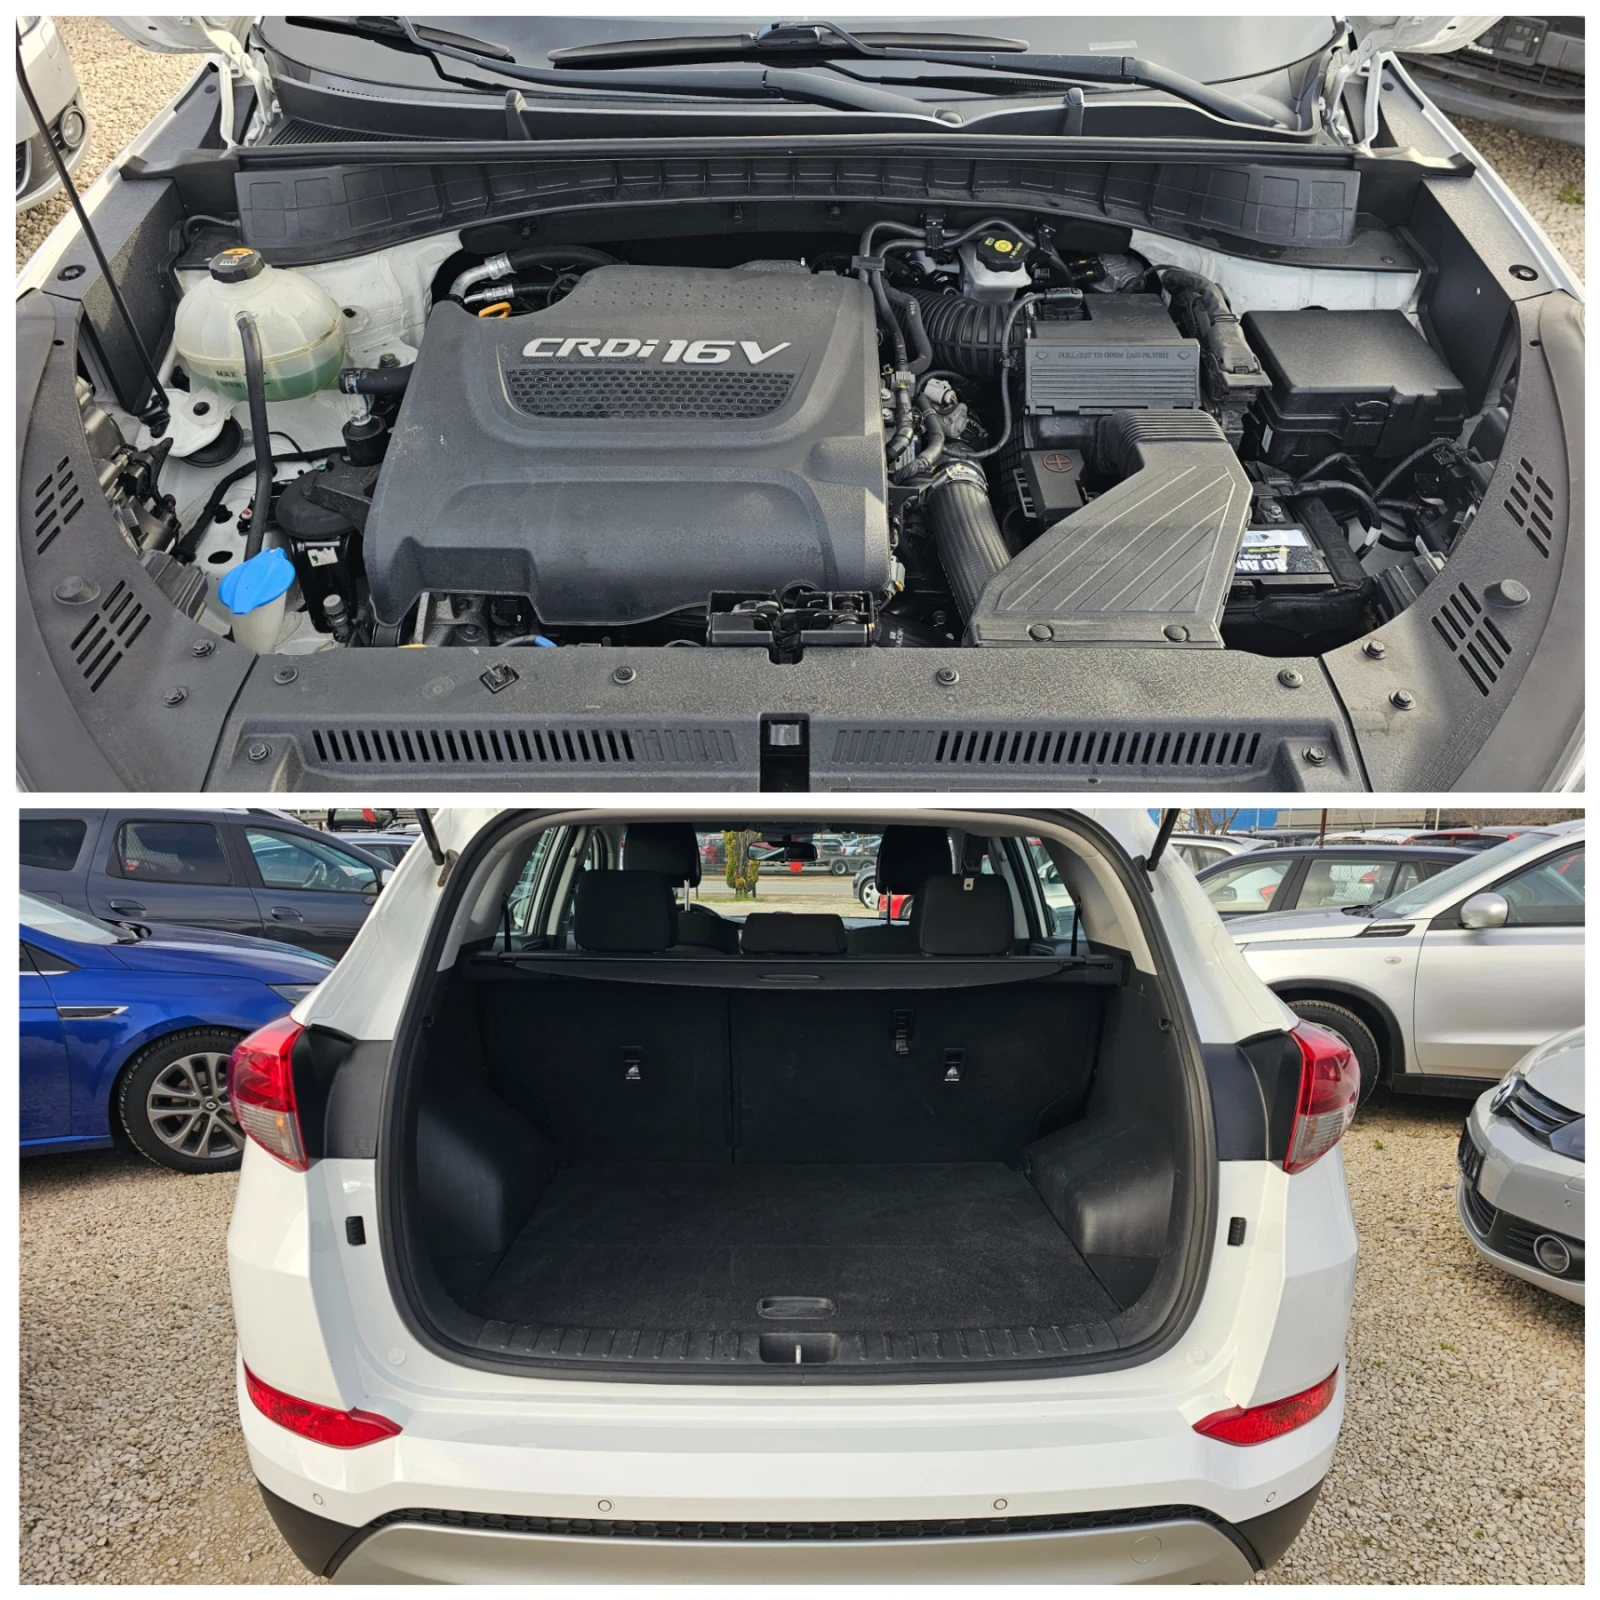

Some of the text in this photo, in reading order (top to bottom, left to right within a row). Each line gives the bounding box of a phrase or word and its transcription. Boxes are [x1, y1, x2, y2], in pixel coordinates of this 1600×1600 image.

[522, 337, 792, 365] CRDi 16V
[216, 370, 237, 378] MAX
